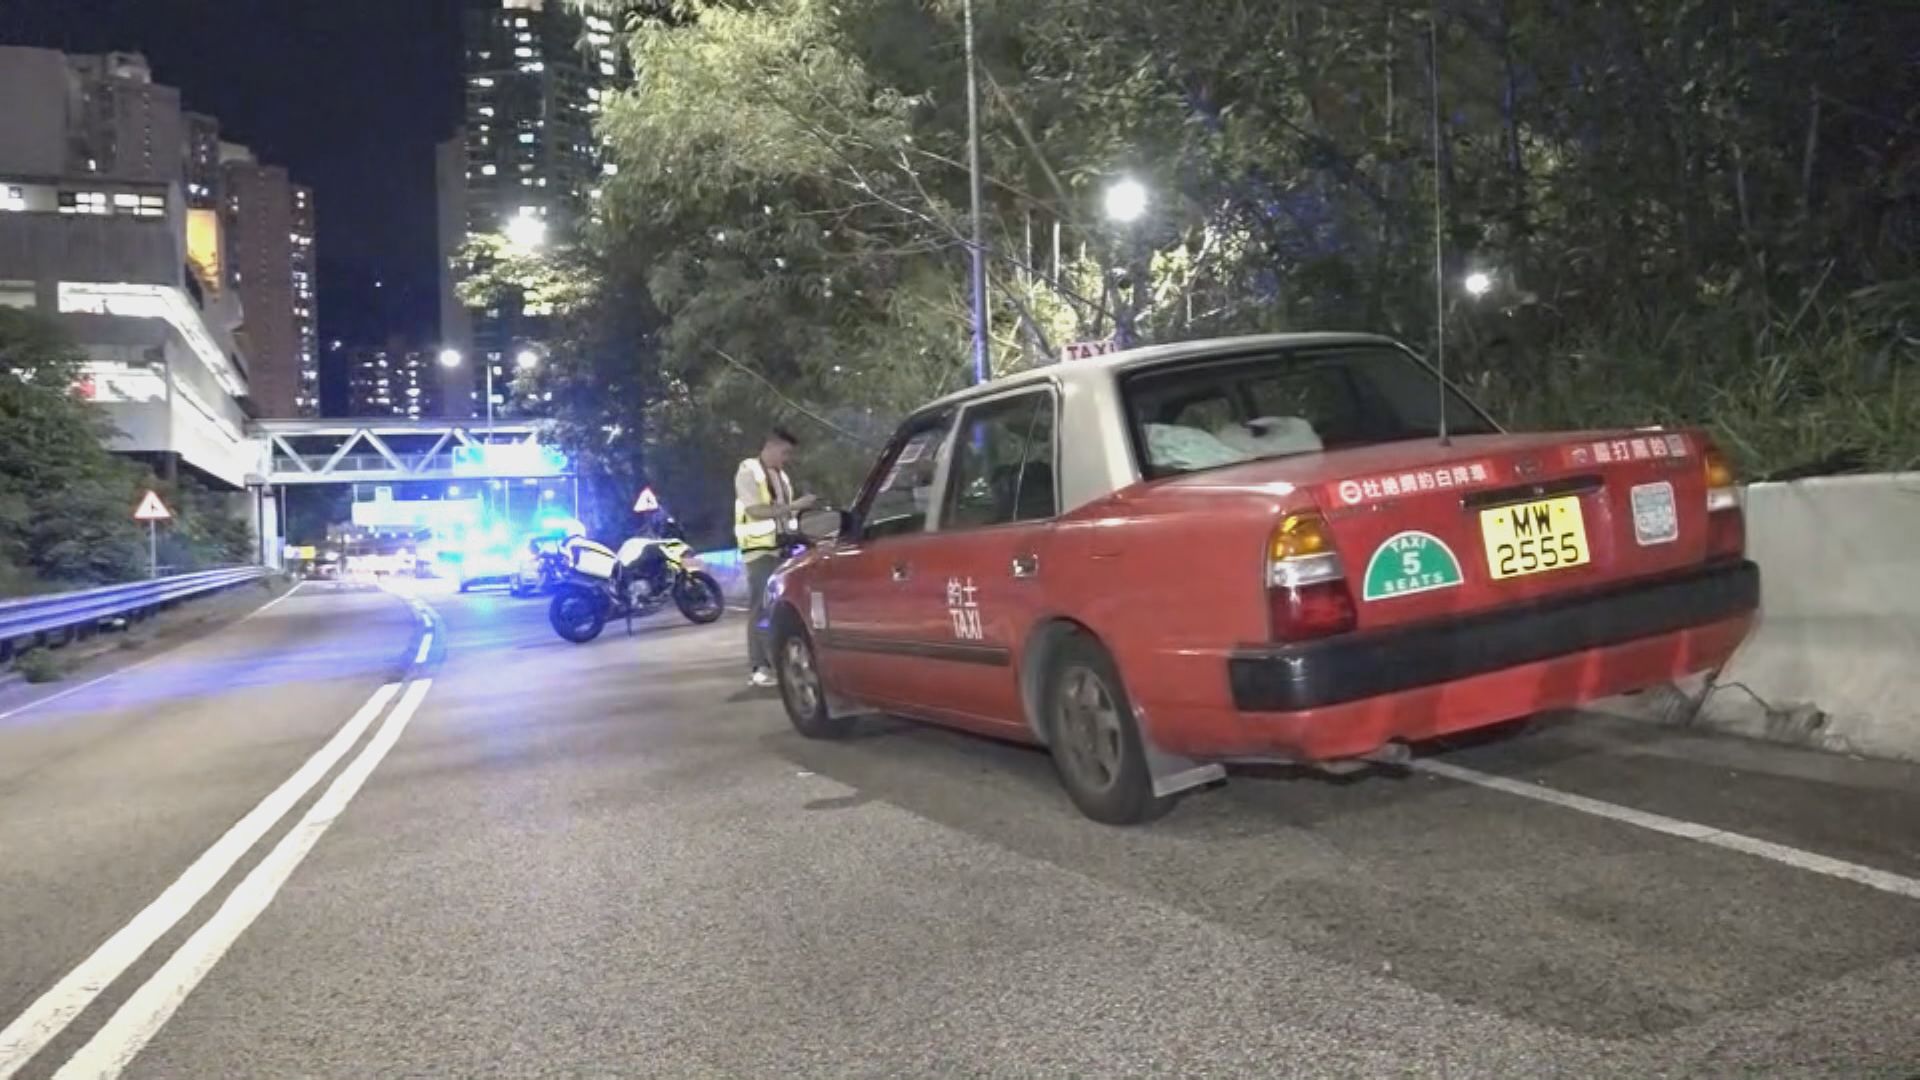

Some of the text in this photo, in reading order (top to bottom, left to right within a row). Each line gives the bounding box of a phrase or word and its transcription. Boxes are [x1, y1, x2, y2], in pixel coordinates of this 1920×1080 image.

[1511, 504, 1552, 538] MW
[1390, 536, 1427, 553] TAXI
[1497, 532, 1579, 575] 2555
[1403, 551, 1421, 575] 5
[947, 576, 978, 607] 的士
[1384, 571, 1444, 592] SEATS
[949, 608, 983, 640] TAXI
